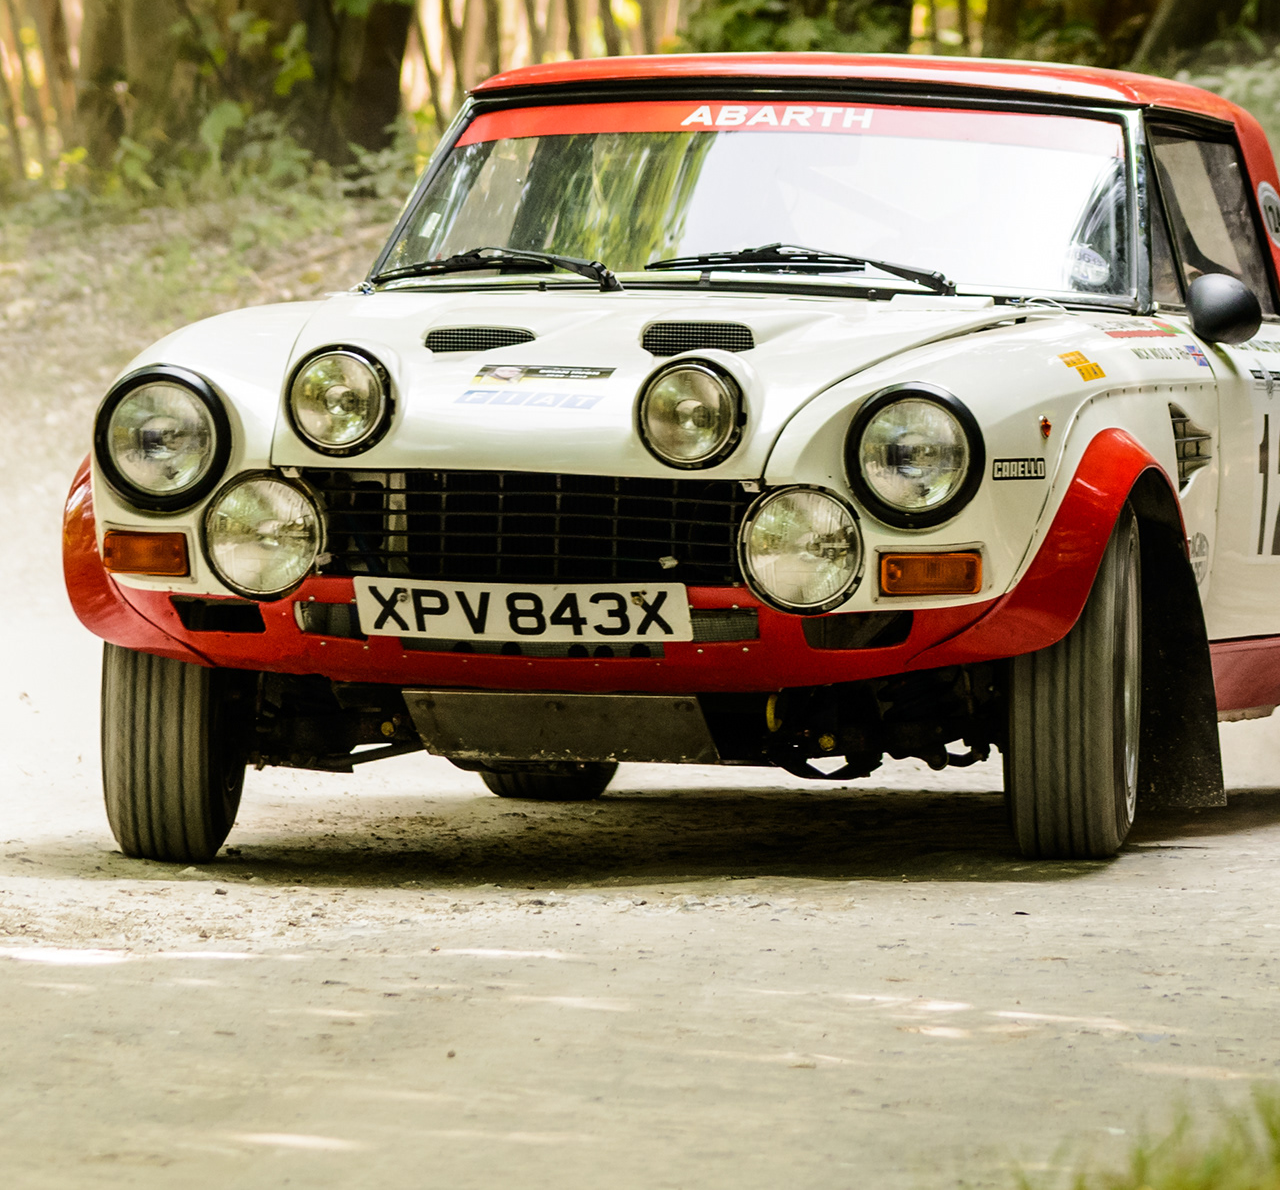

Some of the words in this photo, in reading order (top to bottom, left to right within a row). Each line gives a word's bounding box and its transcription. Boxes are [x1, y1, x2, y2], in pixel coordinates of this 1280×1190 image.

[680, 104, 873, 130] ABARTH
[461, 391, 597, 407] FIAT
[993, 461, 1045, 478] CARELLO
[368, 585, 491, 635] XPV
[505, 590, 674, 636] 843X
